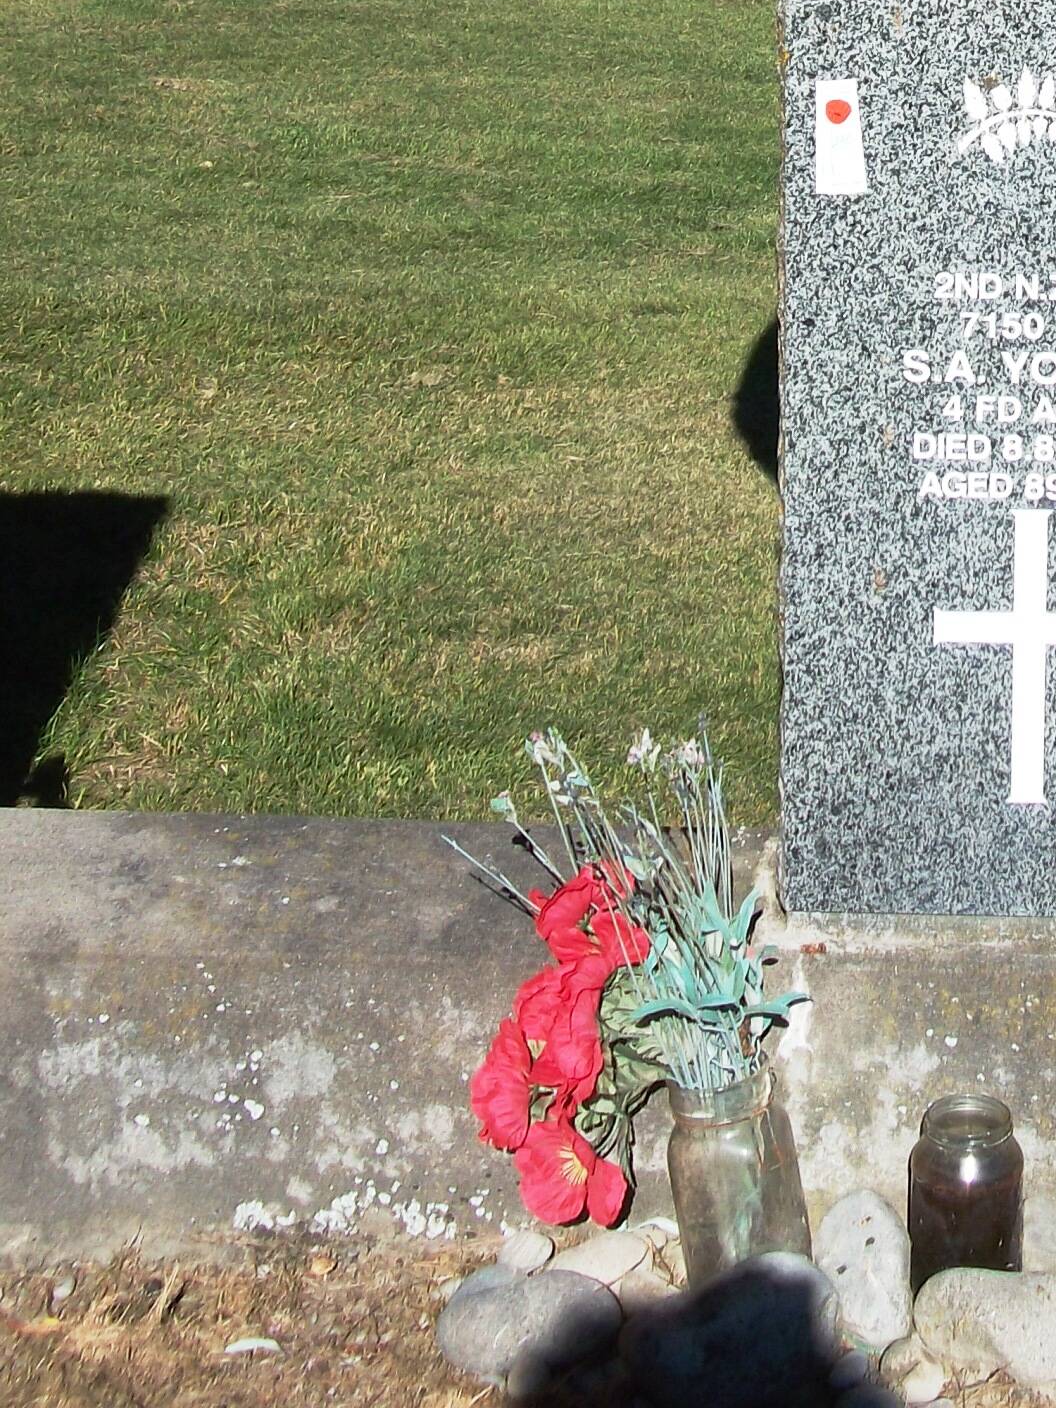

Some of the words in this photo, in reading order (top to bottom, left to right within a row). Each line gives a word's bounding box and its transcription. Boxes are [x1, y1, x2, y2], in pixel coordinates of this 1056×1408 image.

[934, 272, 1002, 300] 2ND
[960, 313, 1044, 340] 7150
[903, 350, 986, 383] S.A.
[943, 396, 960, 421] 4
[977, 396, 1022, 422] FD
[913, 433, 991, 461] DIED
[920, 473, 1013, 498] AGED
